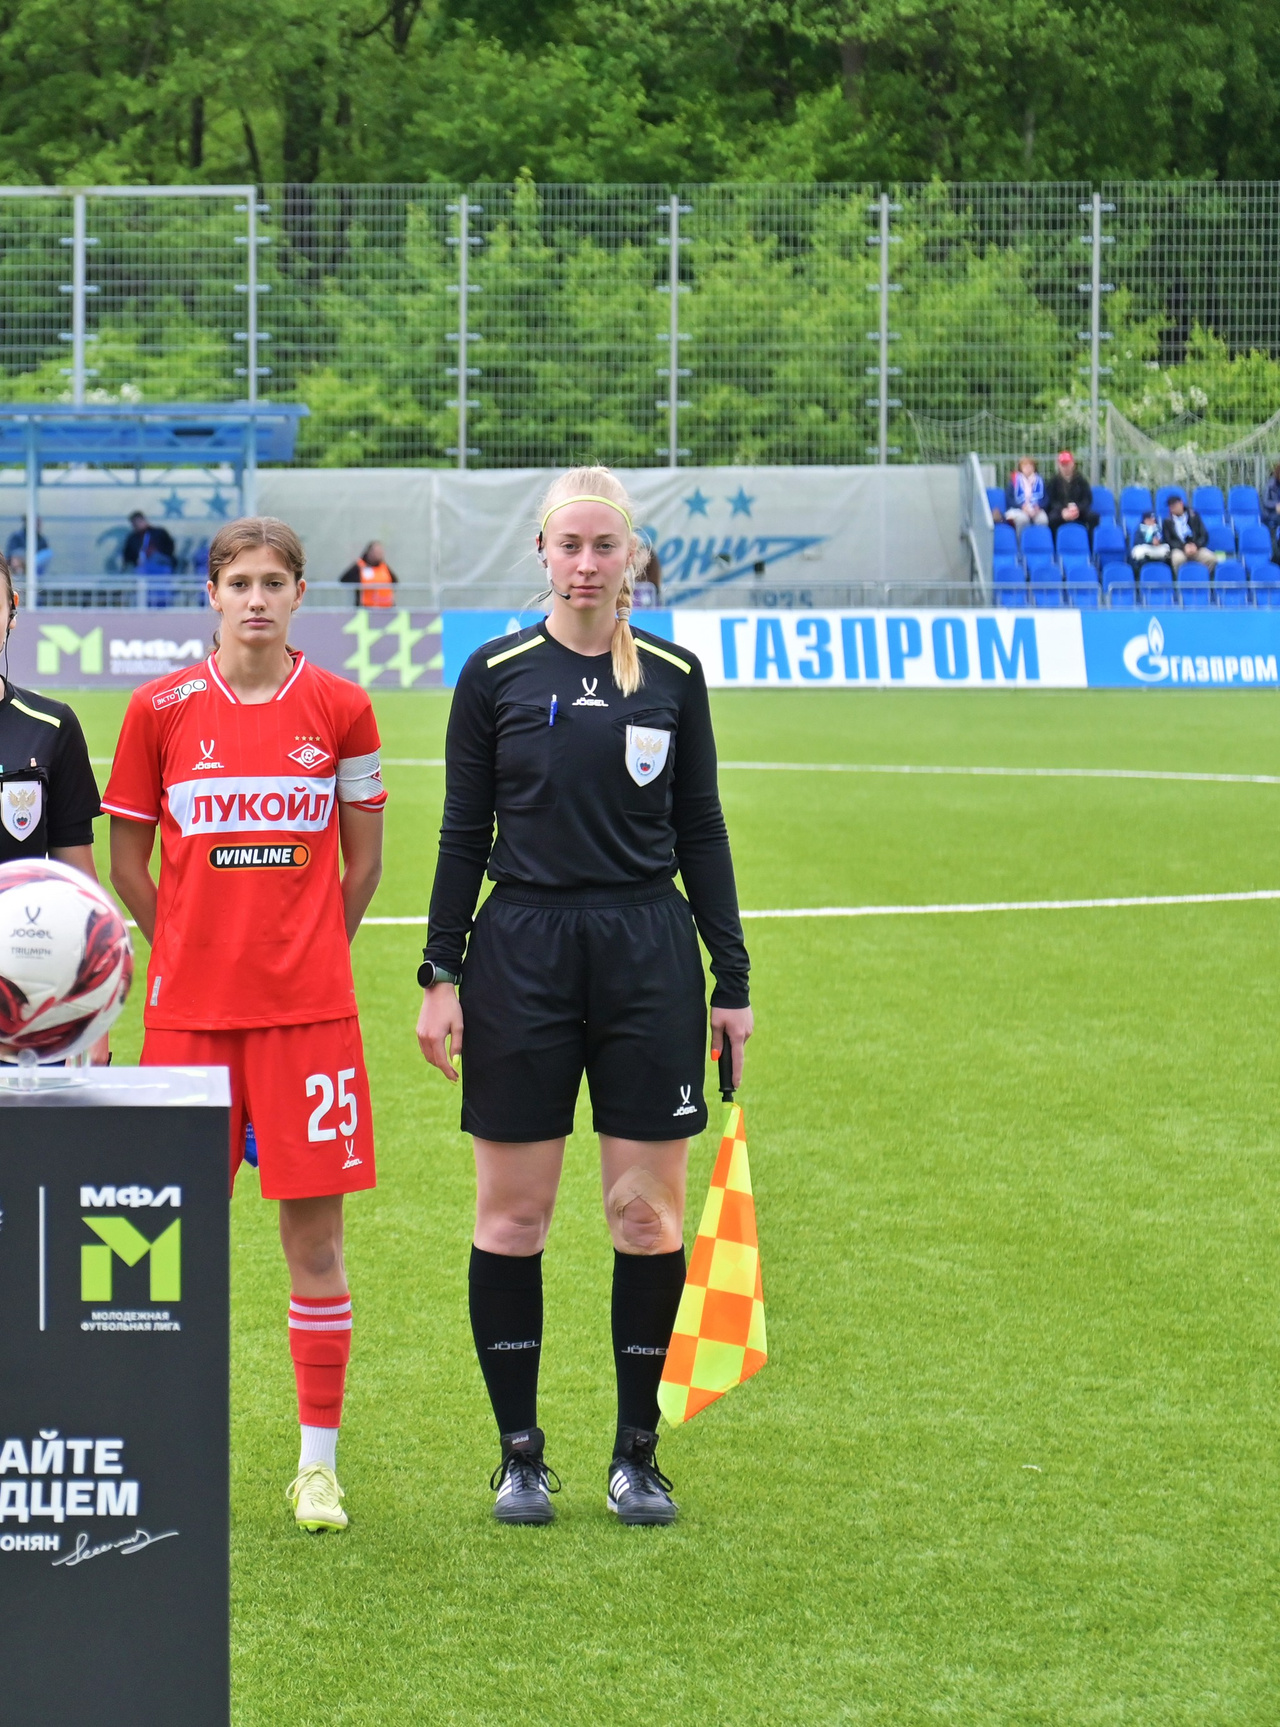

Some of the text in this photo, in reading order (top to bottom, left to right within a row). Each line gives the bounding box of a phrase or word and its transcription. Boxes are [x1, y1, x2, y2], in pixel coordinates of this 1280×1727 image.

[720, 617, 1040, 680] ГАЗПРОМ
[1170, 655, 1278, 683] ГАЗПРОМ
[192, 761, 224, 771] JÖGEL
[192, 786, 330, 825] ЛУКОЙЛ
[216, 848, 292, 866] WINLINE
[305, 1067, 358, 1143] 25
[80, 1186, 182, 1208] МФЛ
[91, 1311, 170, 1322] МОЛОДЕЖНАЯ
[80, 1321, 181, 1332] ФУТБОЛЬНАЯ ЛИГА
[487, 1340, 540, 1351] JÖGEL
[621, 1344, 668, 1356] JÖGE
